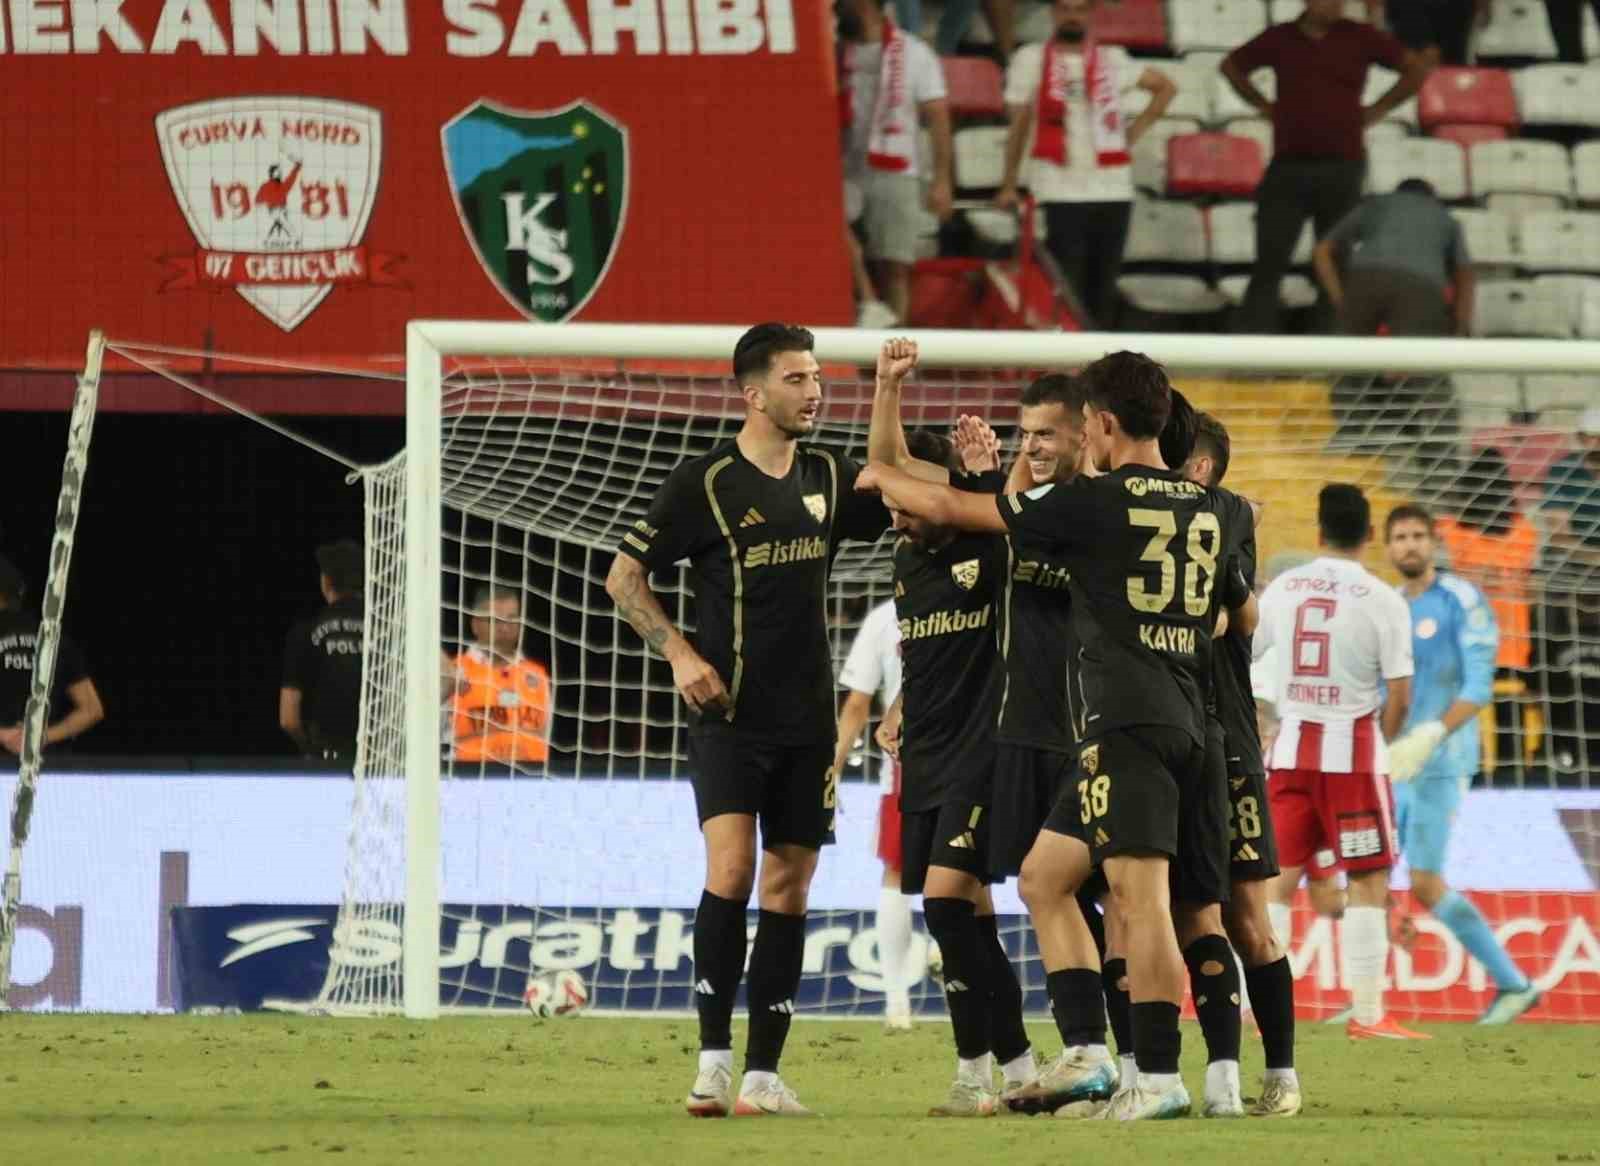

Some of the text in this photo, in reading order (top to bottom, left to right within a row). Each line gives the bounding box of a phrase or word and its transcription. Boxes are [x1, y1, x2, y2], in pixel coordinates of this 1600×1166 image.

[0, 0, 409, 55] EKANIN
[179, 118, 361, 148] CURVA NORD
[205, 254, 233, 280] 07
[1126, 507, 1220, 617] 38
[911, 602, 991, 640] istikbal
[1139, 624, 1196, 656] KAYRA
[1292, 597, 1337, 678] 6
[4, 653, 33, 670] POL
[1078, 775, 1110, 825] 38
